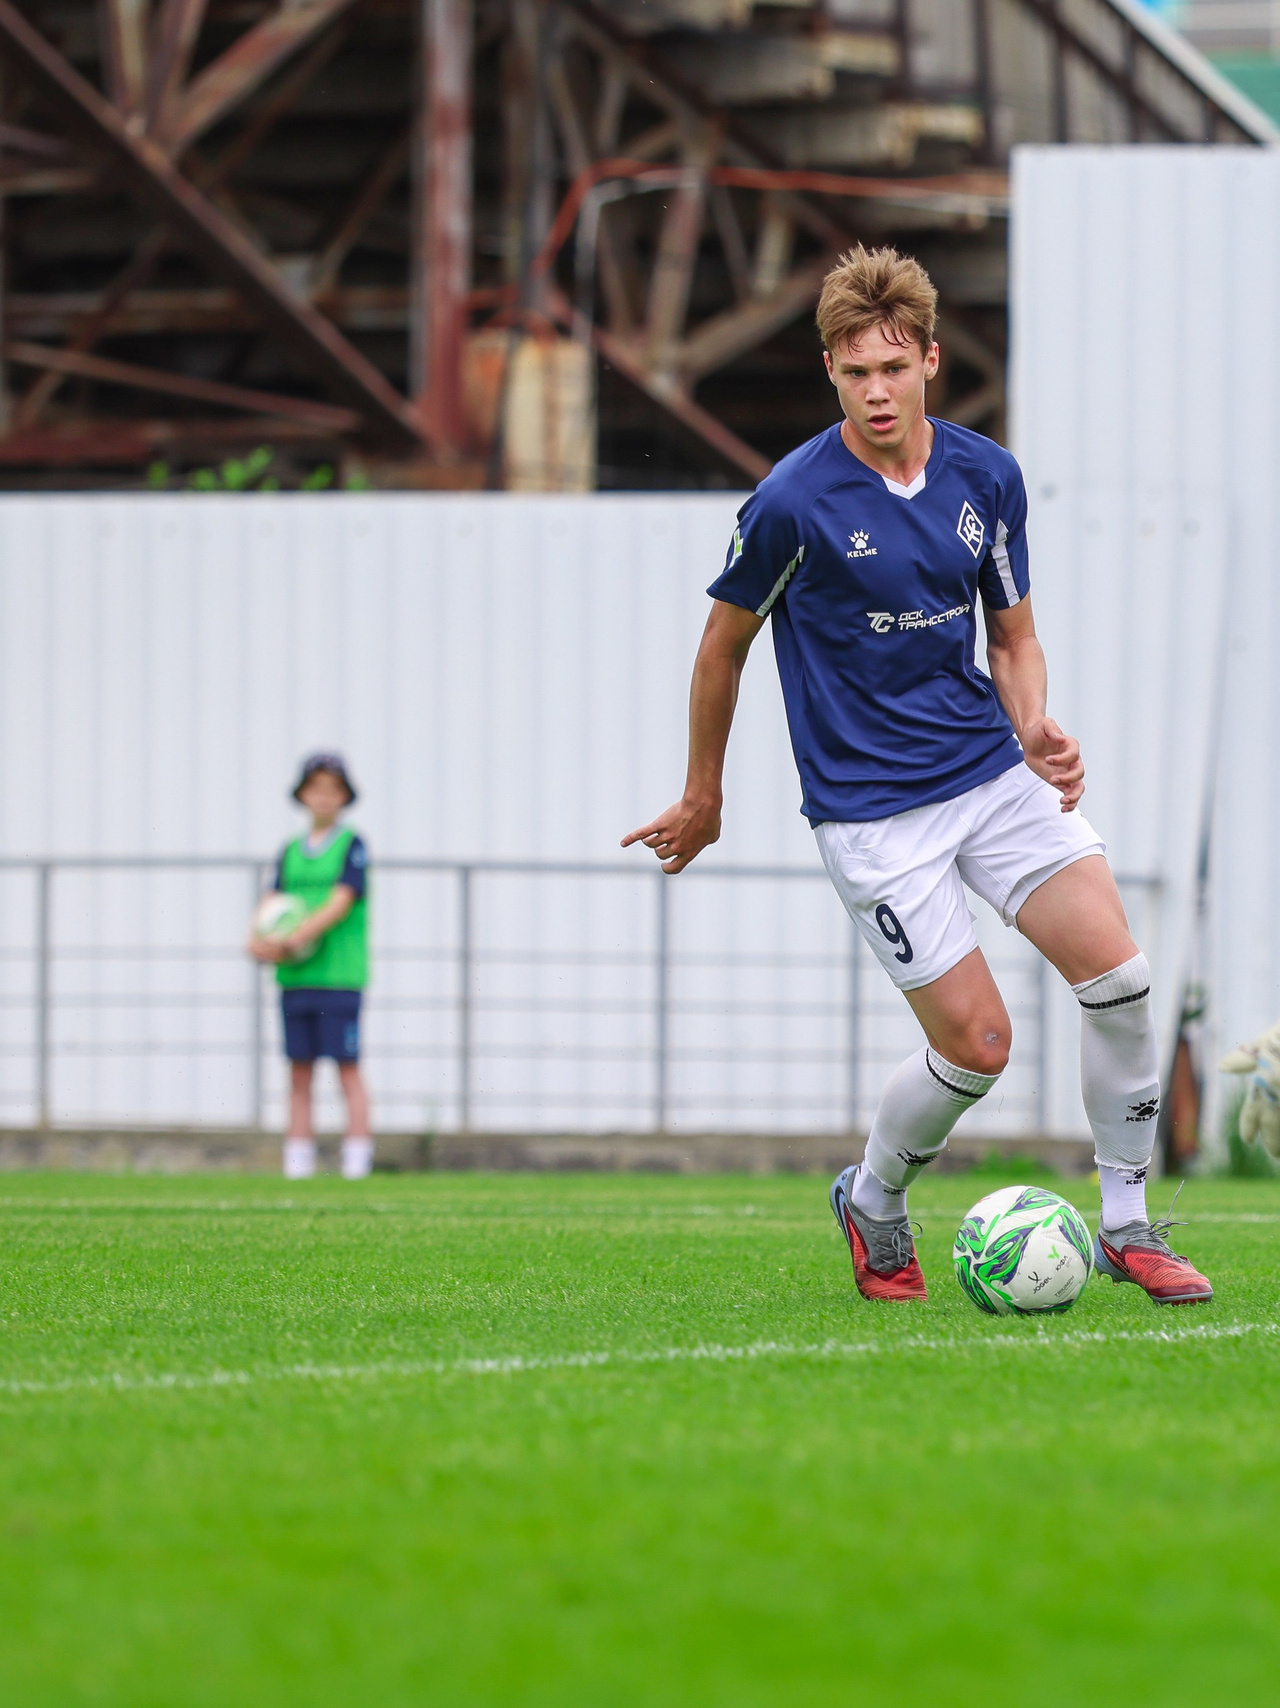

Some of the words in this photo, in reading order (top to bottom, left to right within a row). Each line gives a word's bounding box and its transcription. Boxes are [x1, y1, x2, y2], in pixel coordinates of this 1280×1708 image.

[846, 548, 878, 558] KELME
[898, 609, 924, 622] ДСК
[898, 603, 971, 631] ТРАНССТРОЙ
[875, 903, 913, 964] 9
